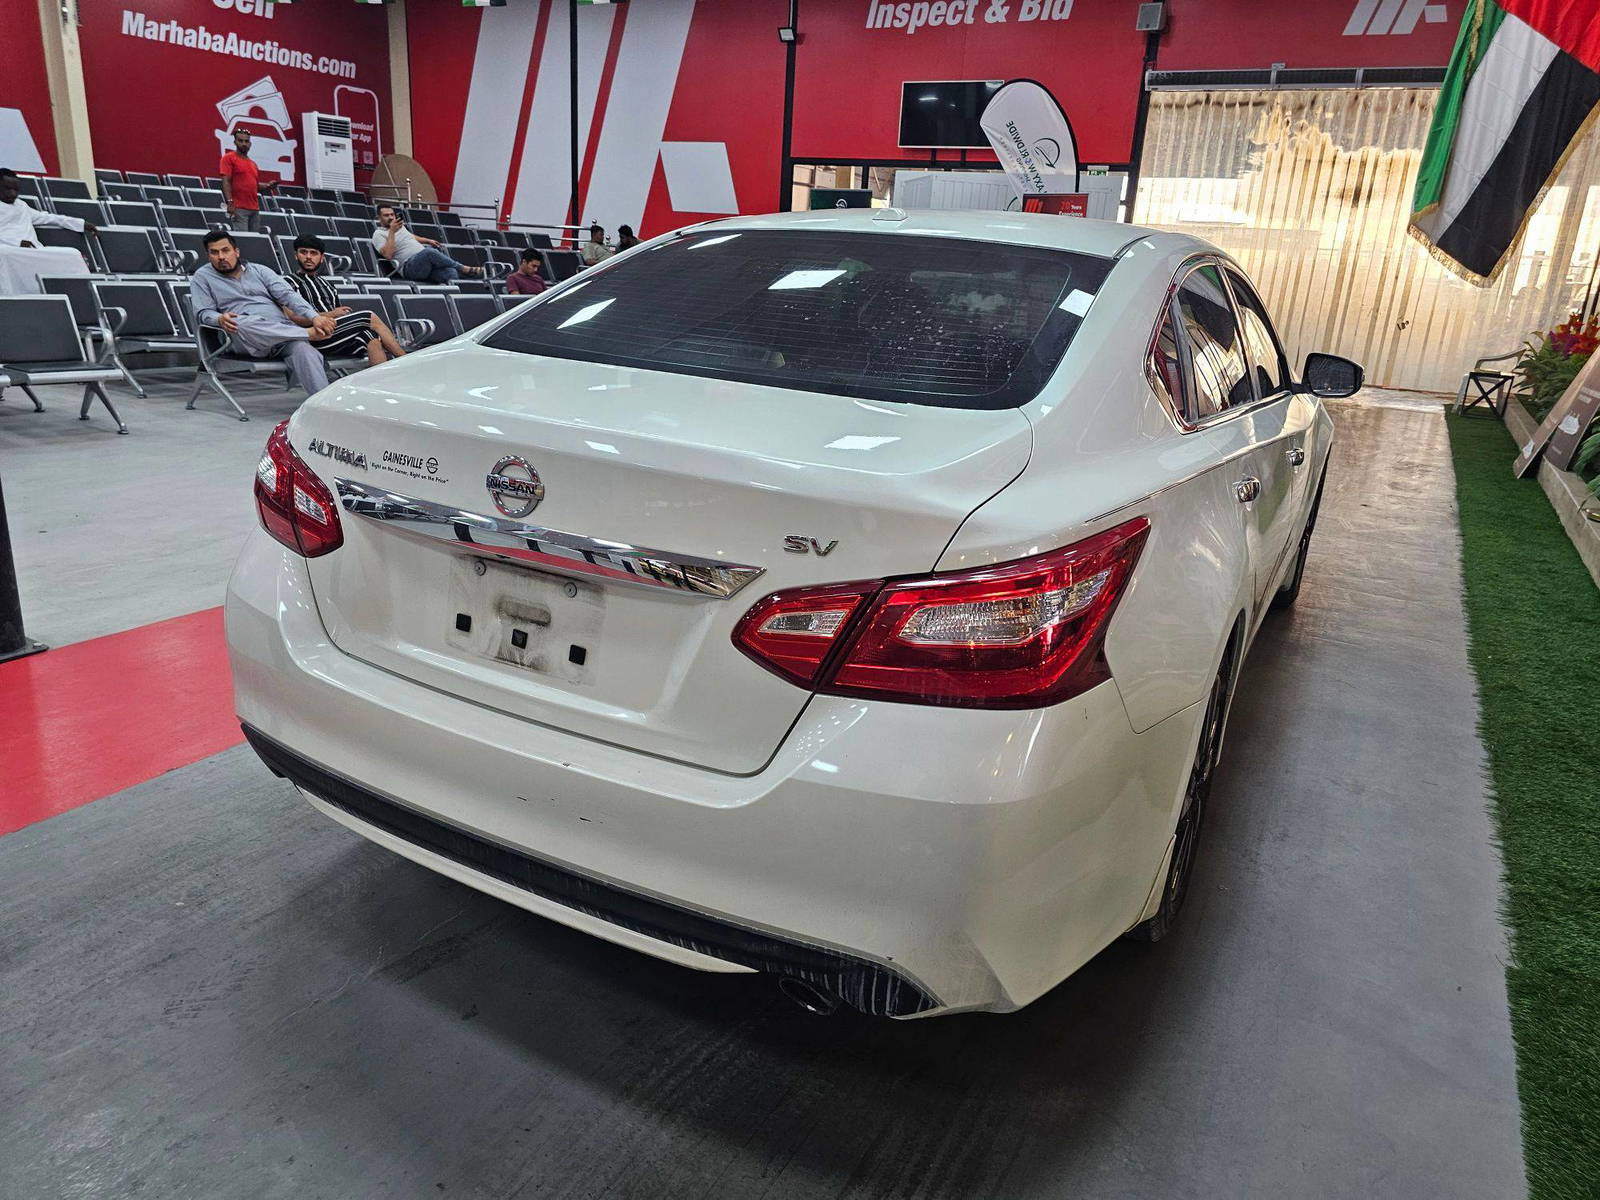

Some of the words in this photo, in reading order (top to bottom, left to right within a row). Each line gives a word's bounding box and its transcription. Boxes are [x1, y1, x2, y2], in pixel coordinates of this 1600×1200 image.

[866, 0, 979, 35] Inspect
[984, 0, 1011, 24] &
[121, 9, 357, 79] MarhabaAuctions.com
[308, 438, 368, 471] ALTIMA
[382, 450, 424, 469] GAINESVILLE
[409, 471, 420, 479] Right
[490, 478, 535, 495] NISSAN
[784, 535, 839, 557] SV
